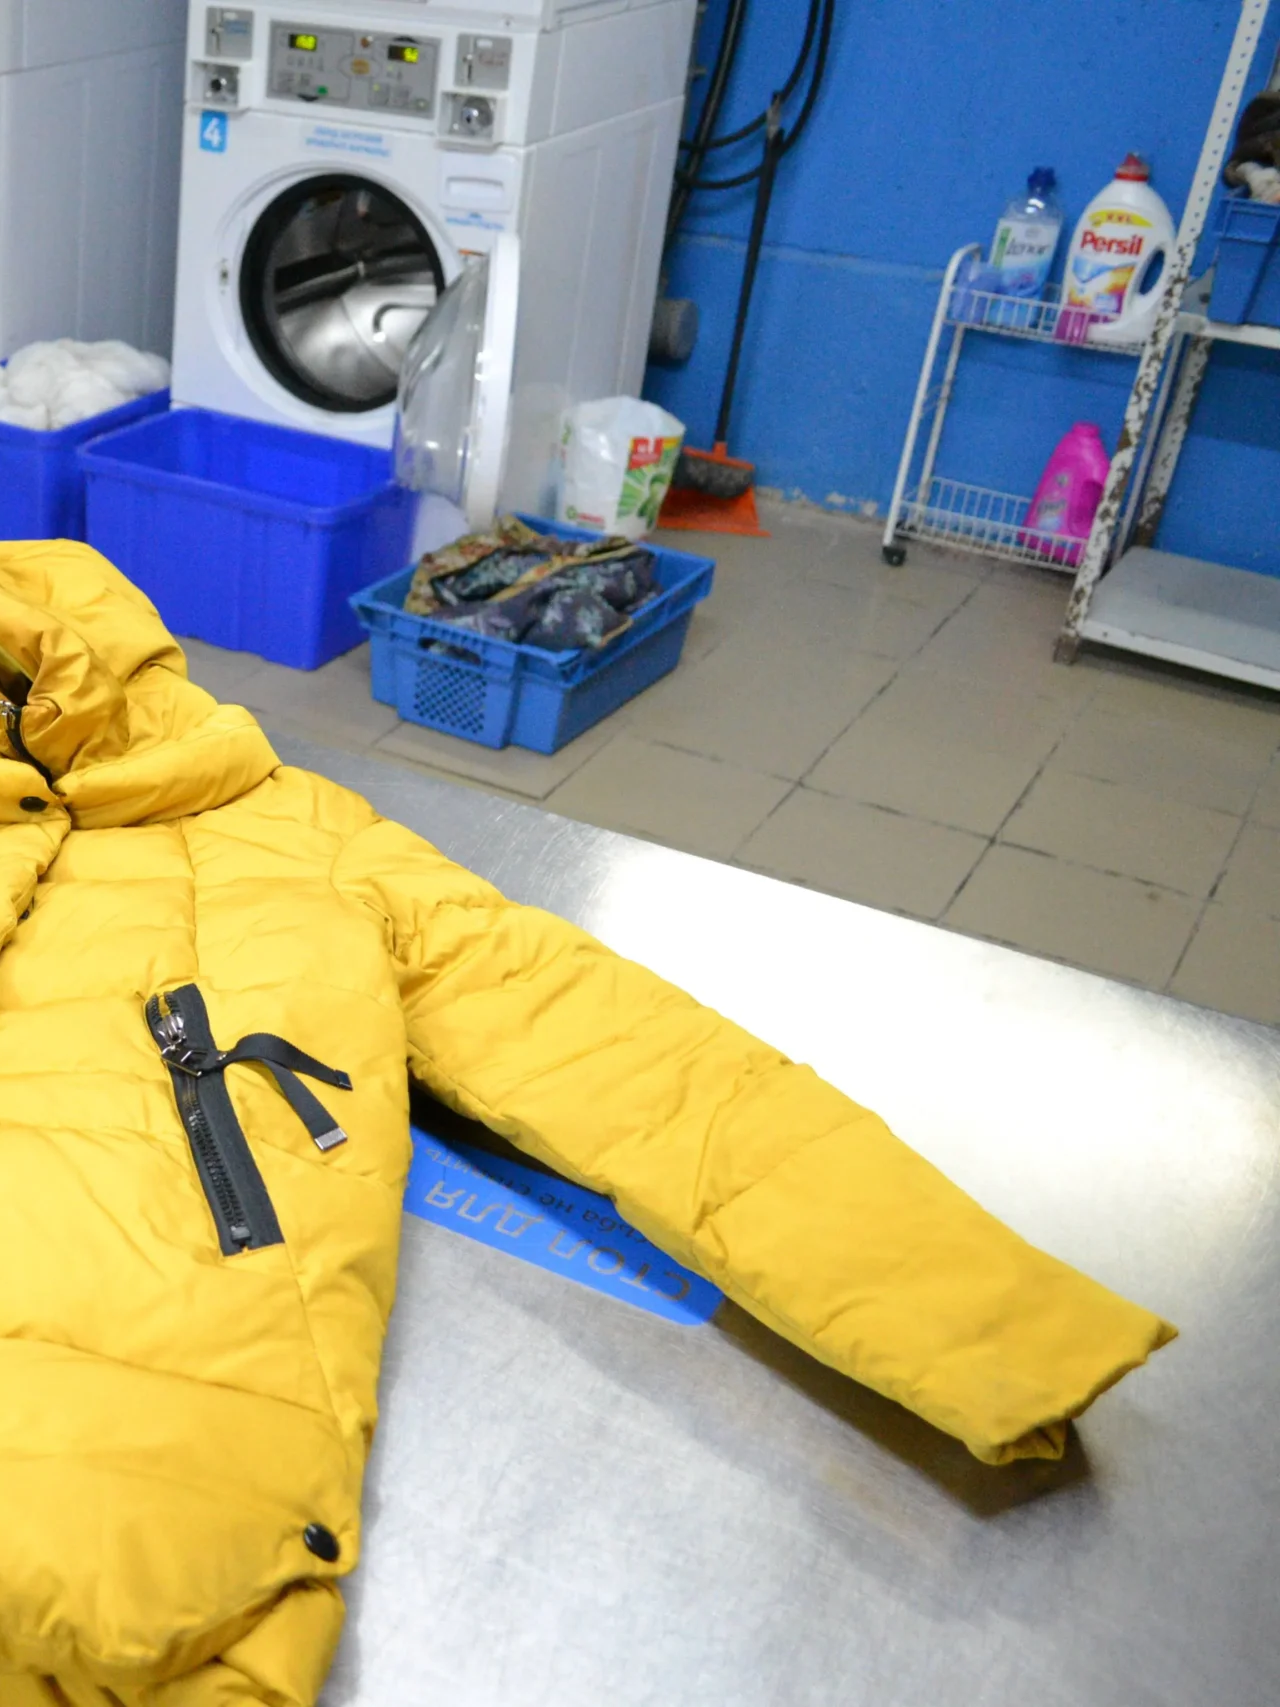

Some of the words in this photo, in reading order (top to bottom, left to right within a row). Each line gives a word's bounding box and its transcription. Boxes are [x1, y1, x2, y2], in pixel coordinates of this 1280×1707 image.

[202, 116, 223, 148] 4
[1080, 229, 1144, 256] Persil
[424, 1179, 545, 1239] ДЛЯ
[547, 1228, 692, 1302] СТОЛ
